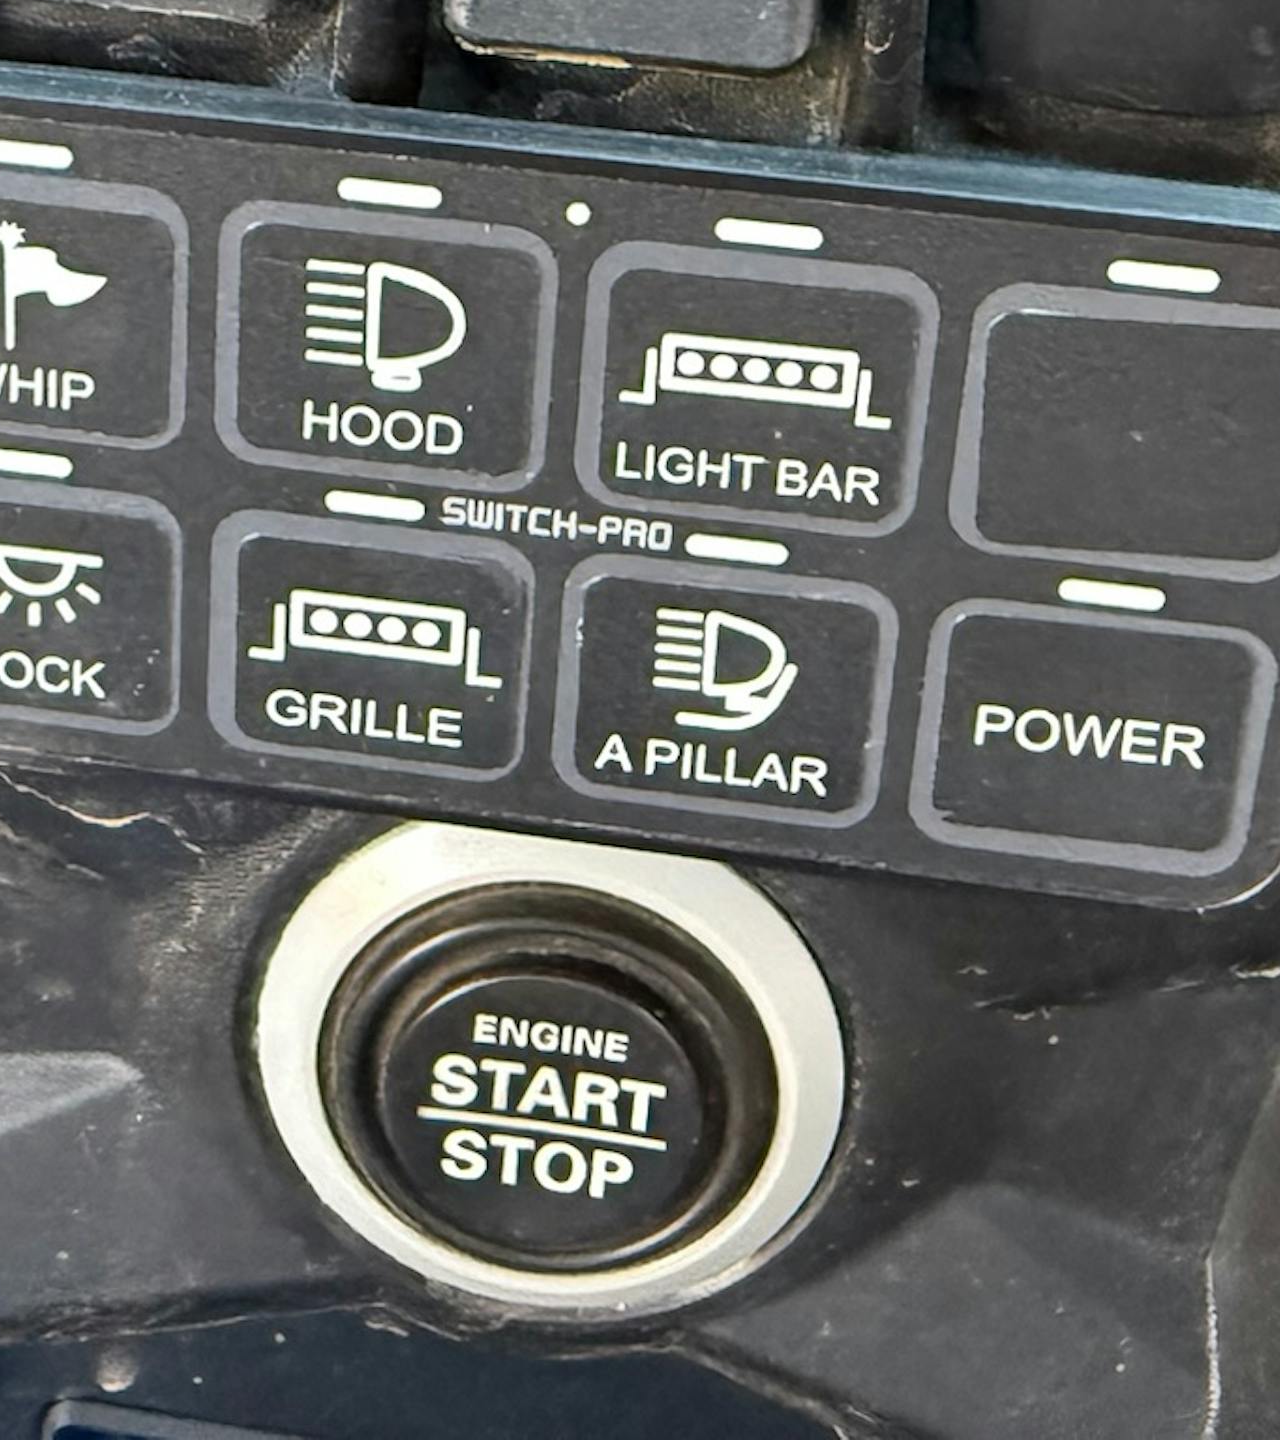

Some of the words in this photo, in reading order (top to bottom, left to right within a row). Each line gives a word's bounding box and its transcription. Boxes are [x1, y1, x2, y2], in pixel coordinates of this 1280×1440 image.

[301, 399, 464, 456] HOOD
[614, 440, 769, 494] LIGHT
[775, 460, 881, 507] BAR
[438, 496, 674, 552] SWITCH-PRO
[265, 688, 463, 749] GRILLE
[973, 703, 1206, 770] POWER
[593, 734, 633, 773] A
[644, 743, 829, 799] PILLAR
[472, 1014, 630, 1062] ENGINE
[430, 1055, 668, 1133] START
[440, 1129, 634, 1200] STOP
